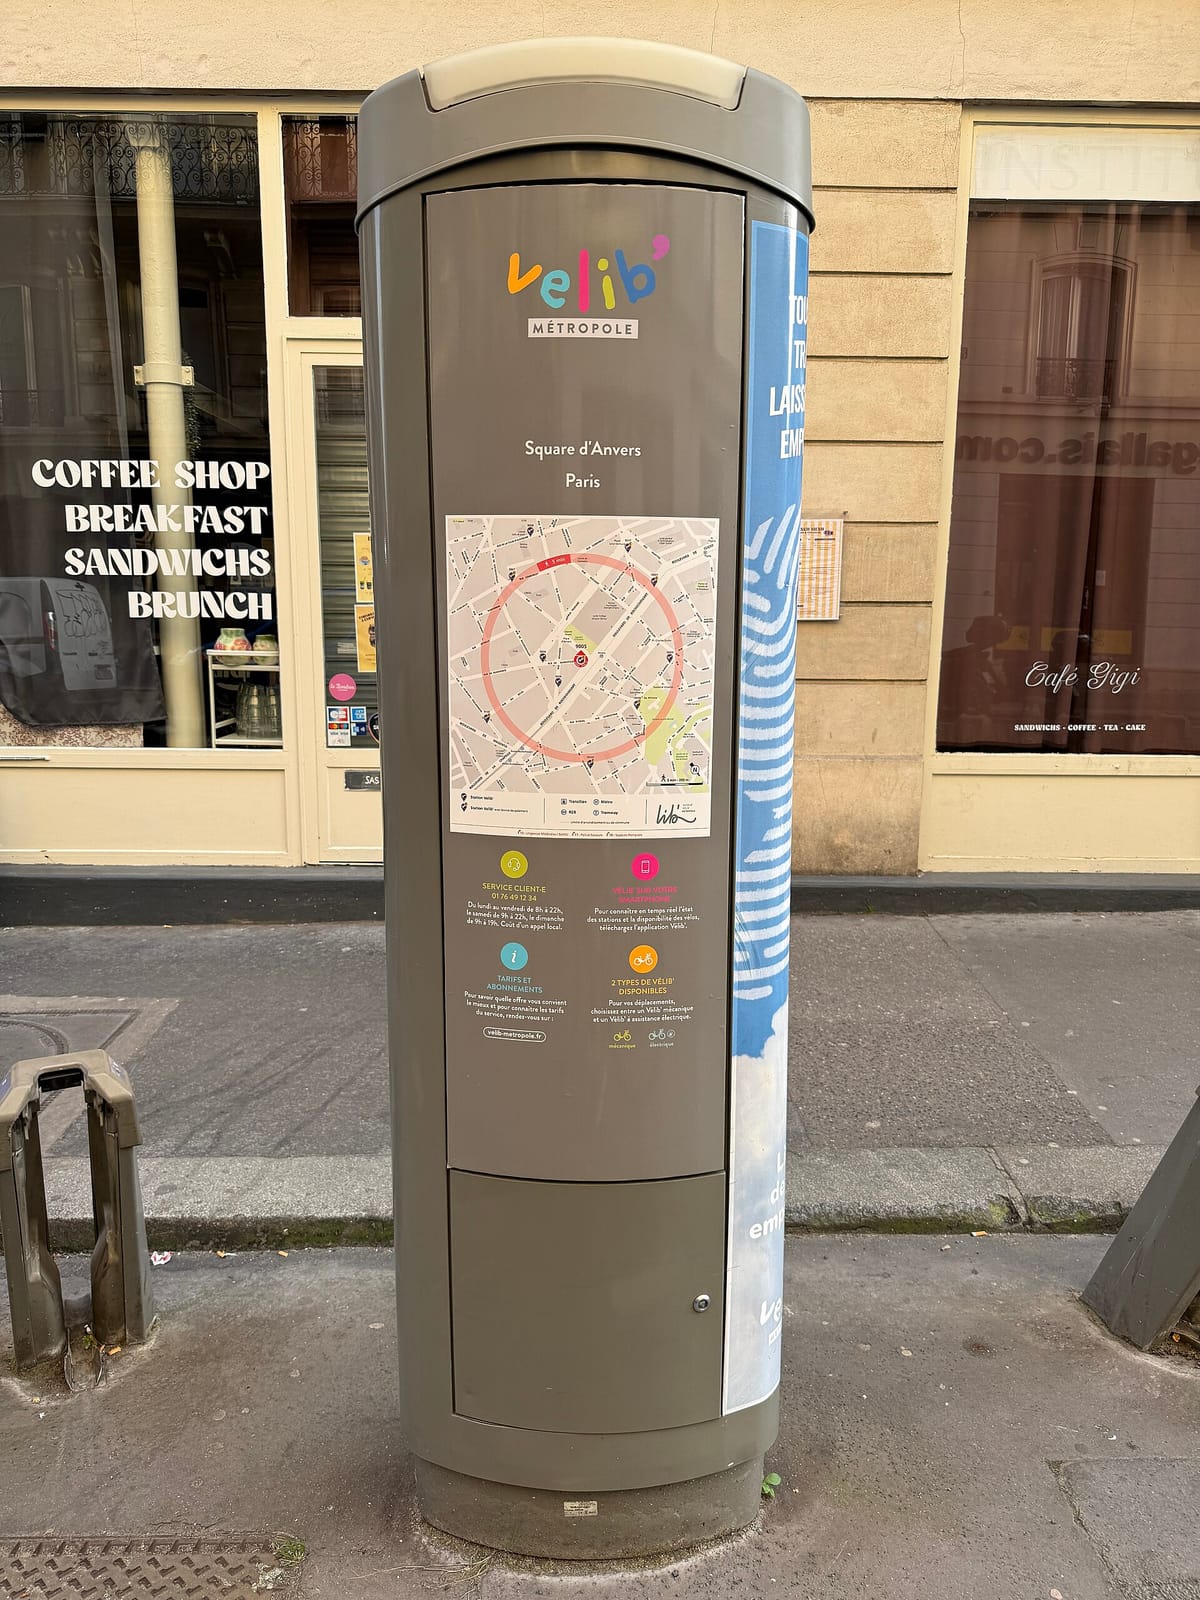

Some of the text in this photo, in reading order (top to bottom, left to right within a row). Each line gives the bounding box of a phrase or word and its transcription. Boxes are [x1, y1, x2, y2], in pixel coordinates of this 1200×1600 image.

[532, 320, 633, 335] MÉTROPOLE
[525, 440, 641, 461] Square d'Anvers
[31, 459, 270, 490] COFFEE SHOP
[565, 473, 600, 488] Paris
[64, 504, 269, 535] BREAKFAST
[64, 547, 271, 577] SANDWICHS
[128, 591, 272, 620] BRUNCH
[1025, 661, 1140, 694] Café Gigi
[482, 882, 512, 891] SERVICE
[477, 901, 491, 910] lundi
[501, 904, 526, 912] vendredi
[527, 905, 534, 913] de
[594, 907, 608, 915] Pour
[647, 908, 666, 916] temps
[472, 910, 492, 918] samedi
[493, 911, 500, 919] de
[535, 914, 565, 922] dimanche
[530, 923, 546, 931] appel
[497, 975, 522, 983] TARIFS
[617, 978, 640, 986] TYPES
[640, 978, 651, 986] DE
[486, 983, 543, 993] ABONNEMENTS
[618, 986, 667, 995] DISPONIBLES
[464, 990, 477, 999] Pour
[478, 993, 494, 1001] savoir
[495, 995, 512, 1003] quelle
[542, 998, 567, 1006] convient
[472, 1000, 489, 1008] mieux
[548, 1006, 565, 1014] tarifs
[590, 1007, 619, 1015] choisissez
[663, 1005, 694, 1013] mécanique
[506, 1012, 540, 1021] rendez-vous
[487, 1029, 542, 1040] velib-metropole.fr
